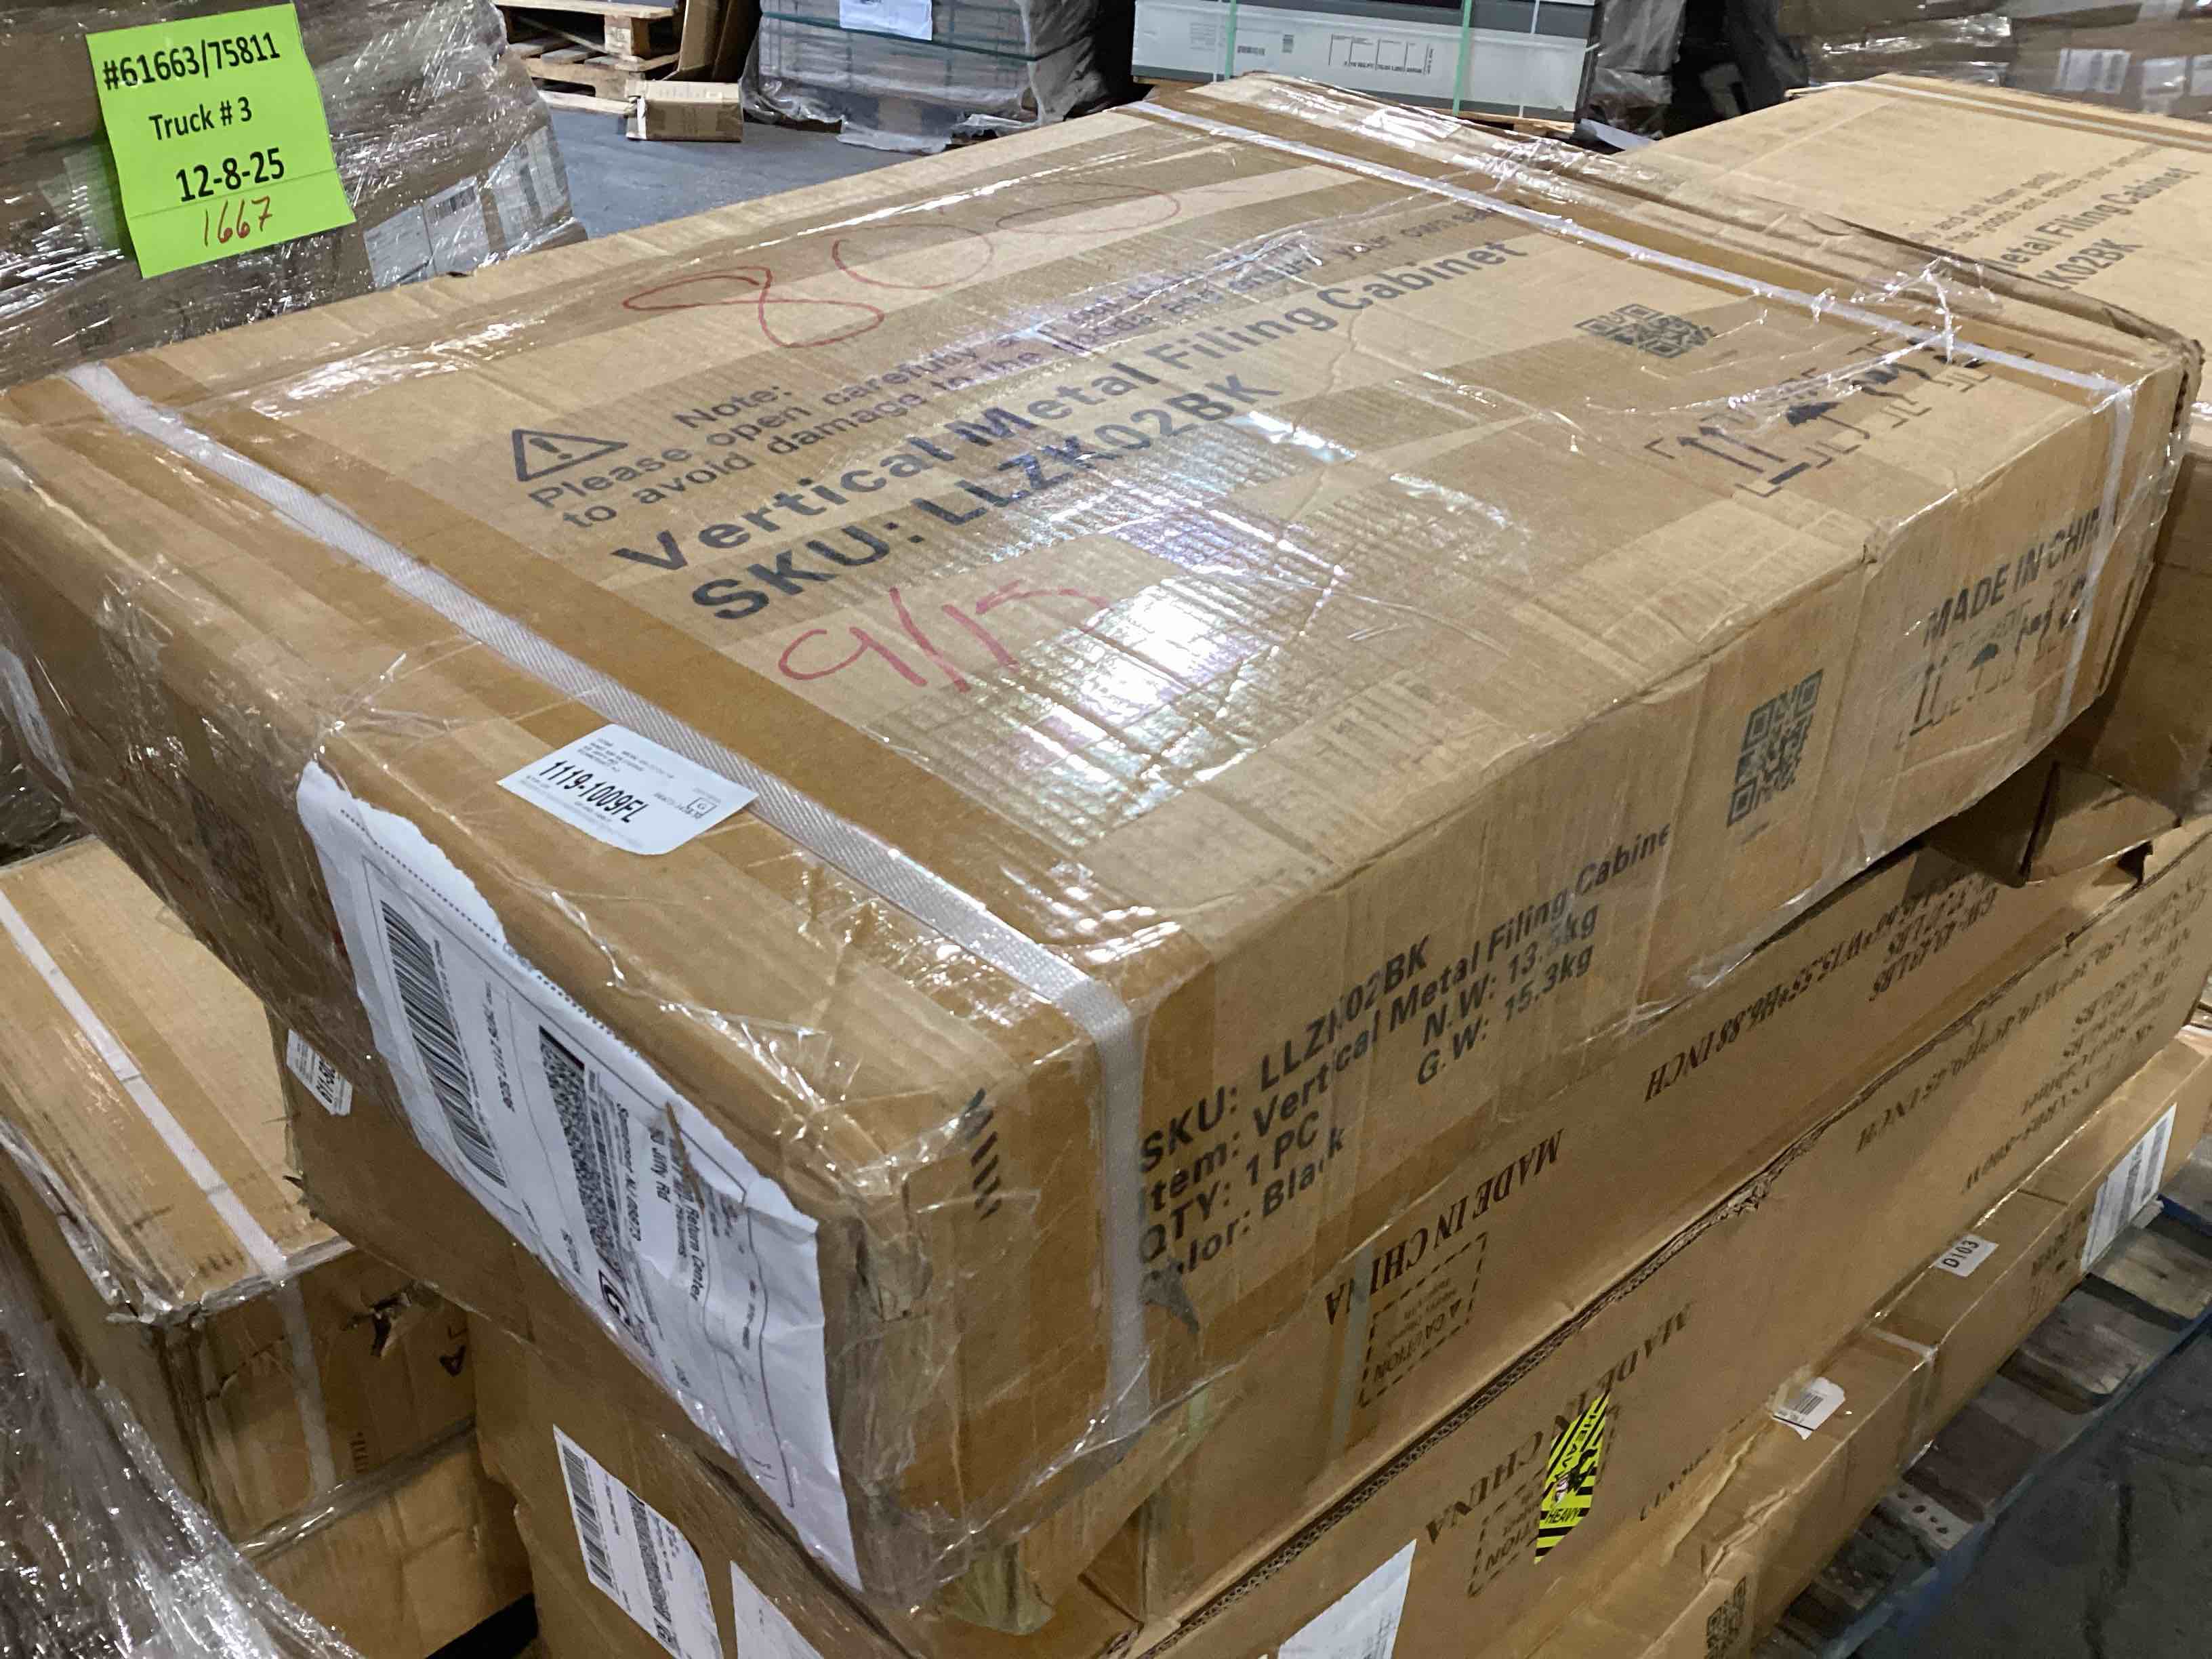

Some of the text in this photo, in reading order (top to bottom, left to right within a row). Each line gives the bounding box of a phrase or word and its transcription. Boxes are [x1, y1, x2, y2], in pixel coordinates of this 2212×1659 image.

[148, 96, 252, 140] Truck # 3
[176, 147, 285, 202] 12-8-25
[204, 195, 272, 247] 1667
[611, 239, 1530, 571] Vertical Metal Filing Cabinet
[673, 384, 792, 428] Note:
[528, 447, 693, 509] Please
[706, 406, 813, 447] open
[563, 504, 618, 529] to
[632, 451, 757, 504] avoid
[766, 392, 928, 455] damage
[692, 521, 925, 619] SKU:
[1923, 562, 2011, 648] MADE
[1504, 945, 1595, 1023] 15.3kg
[1143, 1132, 1240, 1212] tem:
[1253, 1009, 1381, 1138] Vertcal
[1389, 939, 1481, 1032] Metal
[1487, 888, 1568, 962] Filing
[1644, 1036, 1712, 1104] INCH
[1141, 1085, 1237, 1174] SKU:
[1246, 1153, 1259, 1187] 1
[1273, 1110, 1320, 1171] PC
[656, 1180, 672, 1204] Rd
[1472, 1128, 1565, 1220] MADE
[1433, 1195, 1470, 1252] IN
[1942, 1240, 1980, 1269] D103
[690, 1254, 705, 1302] Center
